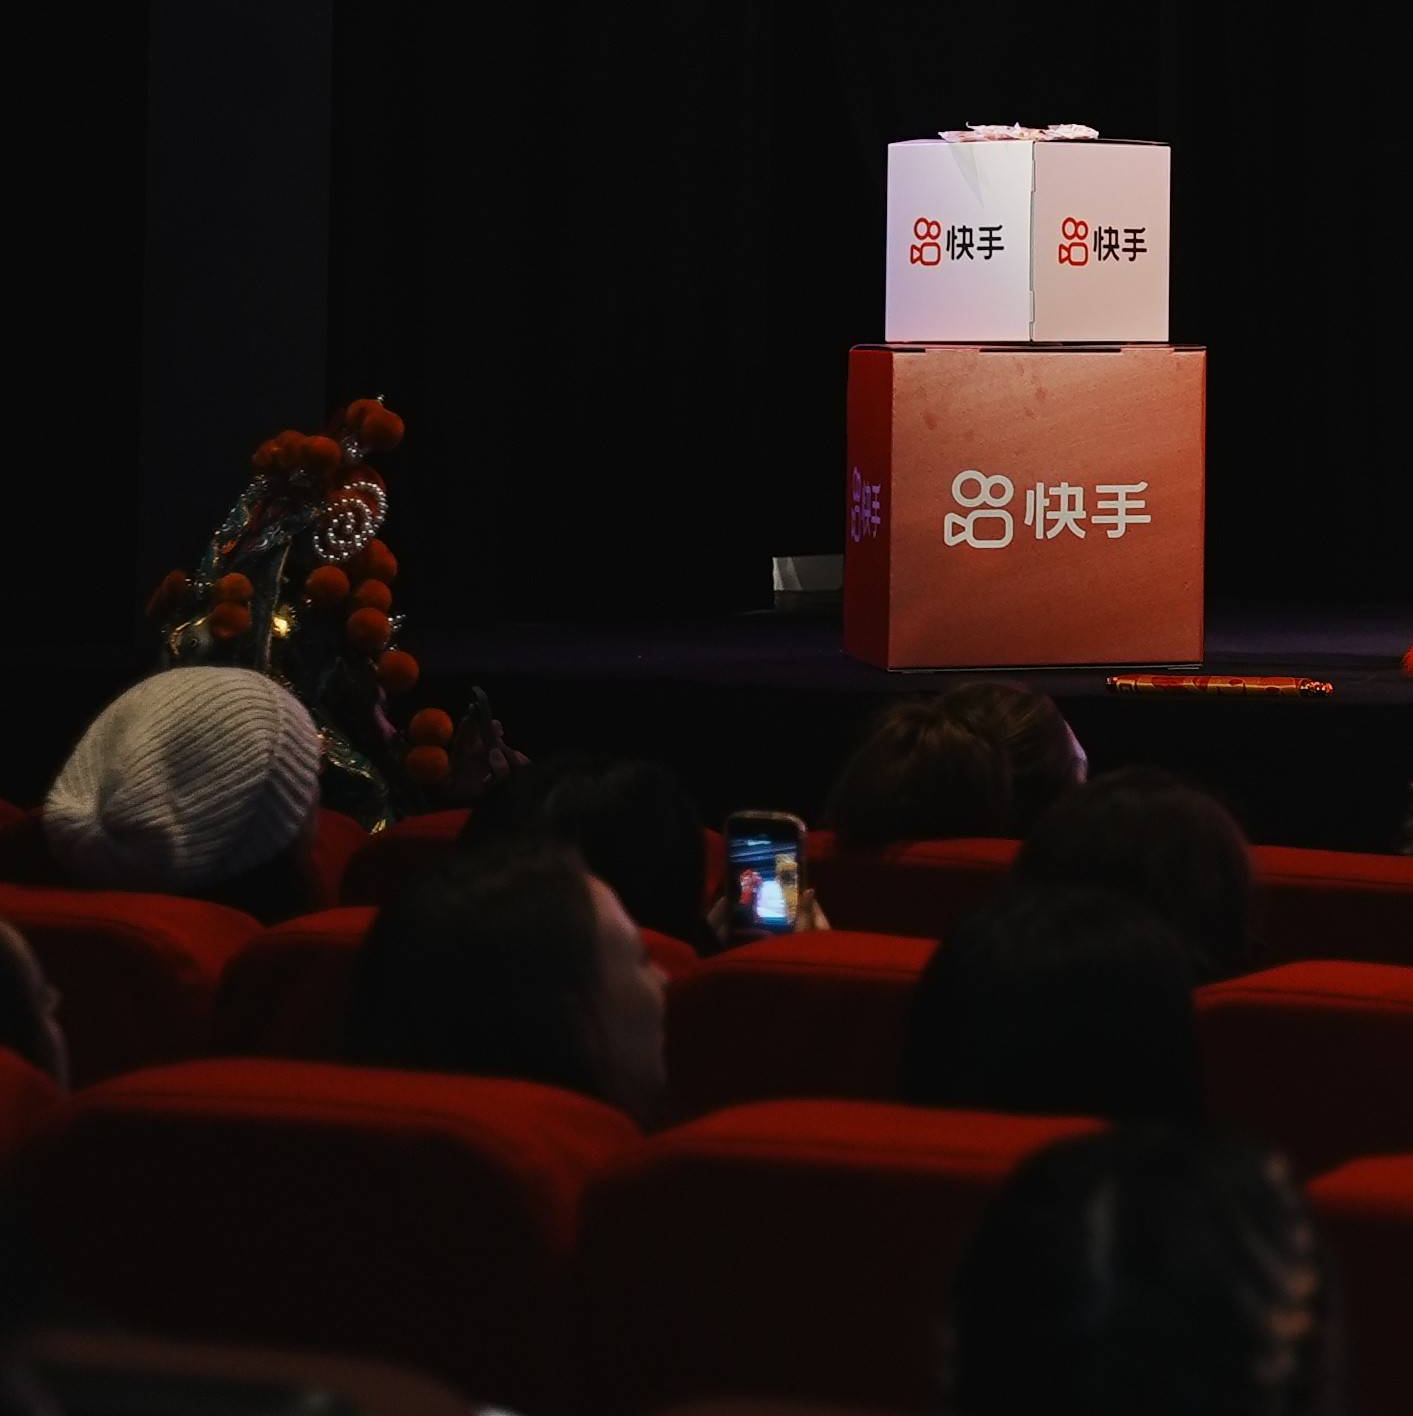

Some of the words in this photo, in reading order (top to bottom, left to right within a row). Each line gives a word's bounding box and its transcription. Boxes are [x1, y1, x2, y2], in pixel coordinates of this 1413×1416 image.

[946, 224, 1005, 261] 快手
[1093, 225, 1148, 262] 快手
[1023, 480, 1152, 540] 快手
